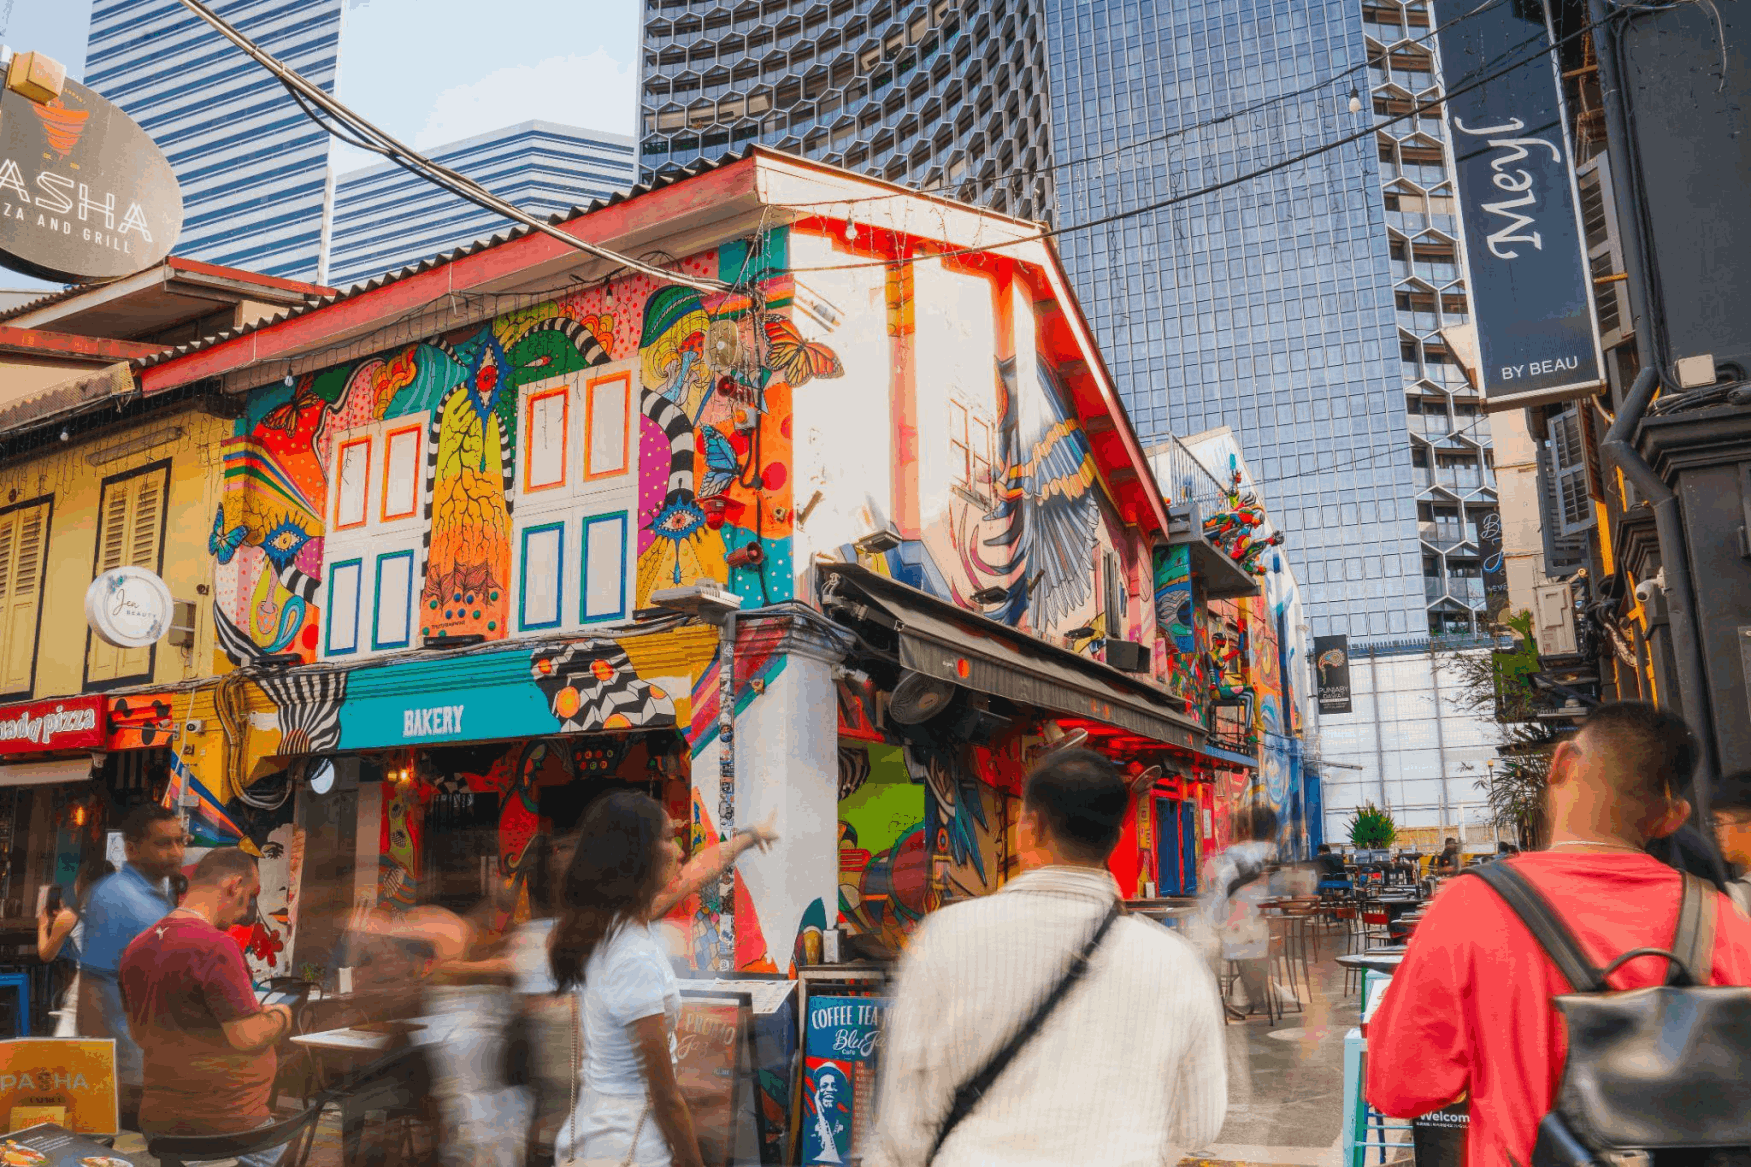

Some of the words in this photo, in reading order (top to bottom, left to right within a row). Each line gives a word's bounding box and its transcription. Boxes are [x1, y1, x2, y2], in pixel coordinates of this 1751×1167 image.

[0, 159, 153, 243] ASHA
[3, 202, 24, 221] ZA
[37, 214, 71, 234] AND
[82, 228, 130, 254] GRILL
[1501, 364, 1525, 380] BY
[1529, 355, 1578, 376] BEAU
[112, 588, 139, 616] Jen
[126, 610, 156, 618] BEAUTY
[42, 705, 96, 744] pizza
[402, 704, 464, 737] BAKERY
[811, 1005, 853, 1029] COFFEE
[858, 1005, 878, 1026] TEA
